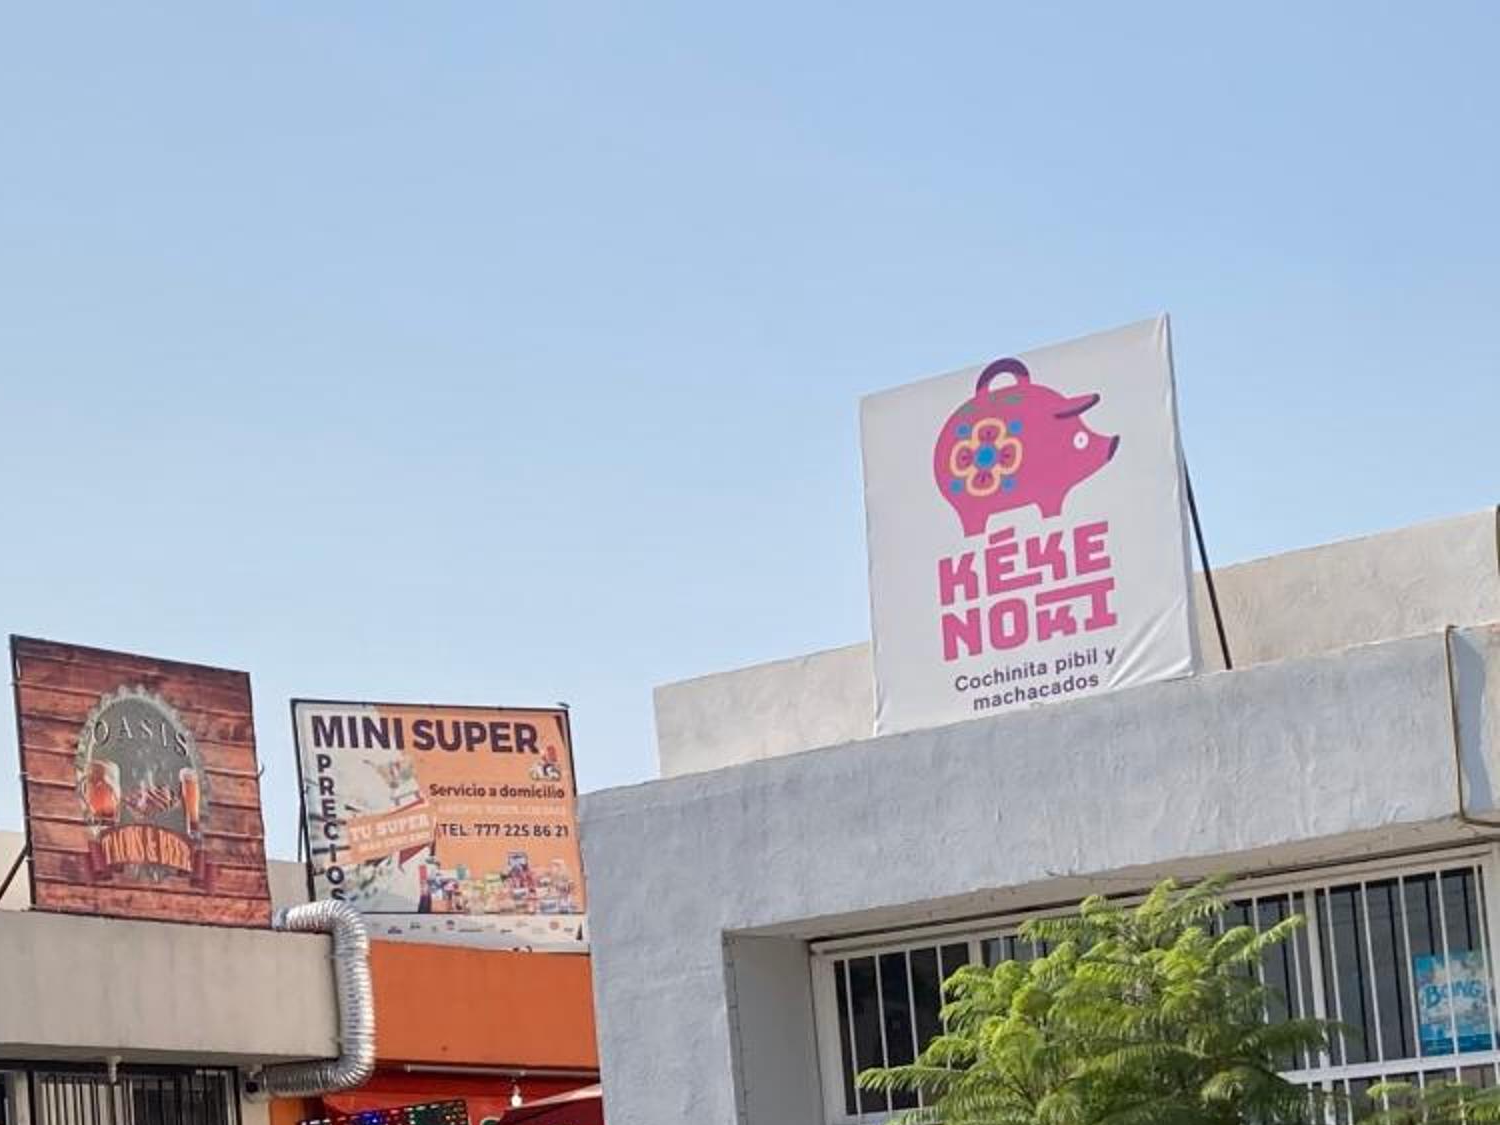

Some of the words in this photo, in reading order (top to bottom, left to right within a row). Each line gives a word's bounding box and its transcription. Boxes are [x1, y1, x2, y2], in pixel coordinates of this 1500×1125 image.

[941, 577, 1118, 662] NOKI
[955, 662, 1048, 692] Cochinita
[1055, 647, 1098, 675] pibil
[1104, 647, 1117, 664] y
[972, 673, 1100, 711] machacados
[91, 715, 189, 757] OASIS
[311, 714, 405, 751] MINI
[411, 718, 540, 755] SUPER
[429, 783, 486, 797] Servicio
[489, 787, 497, 797] a
[499, 784, 565, 799] domicilio
[474, 823, 500, 837] 777
[504, 823, 529, 837] 225
[533, 823, 551, 837] 86
